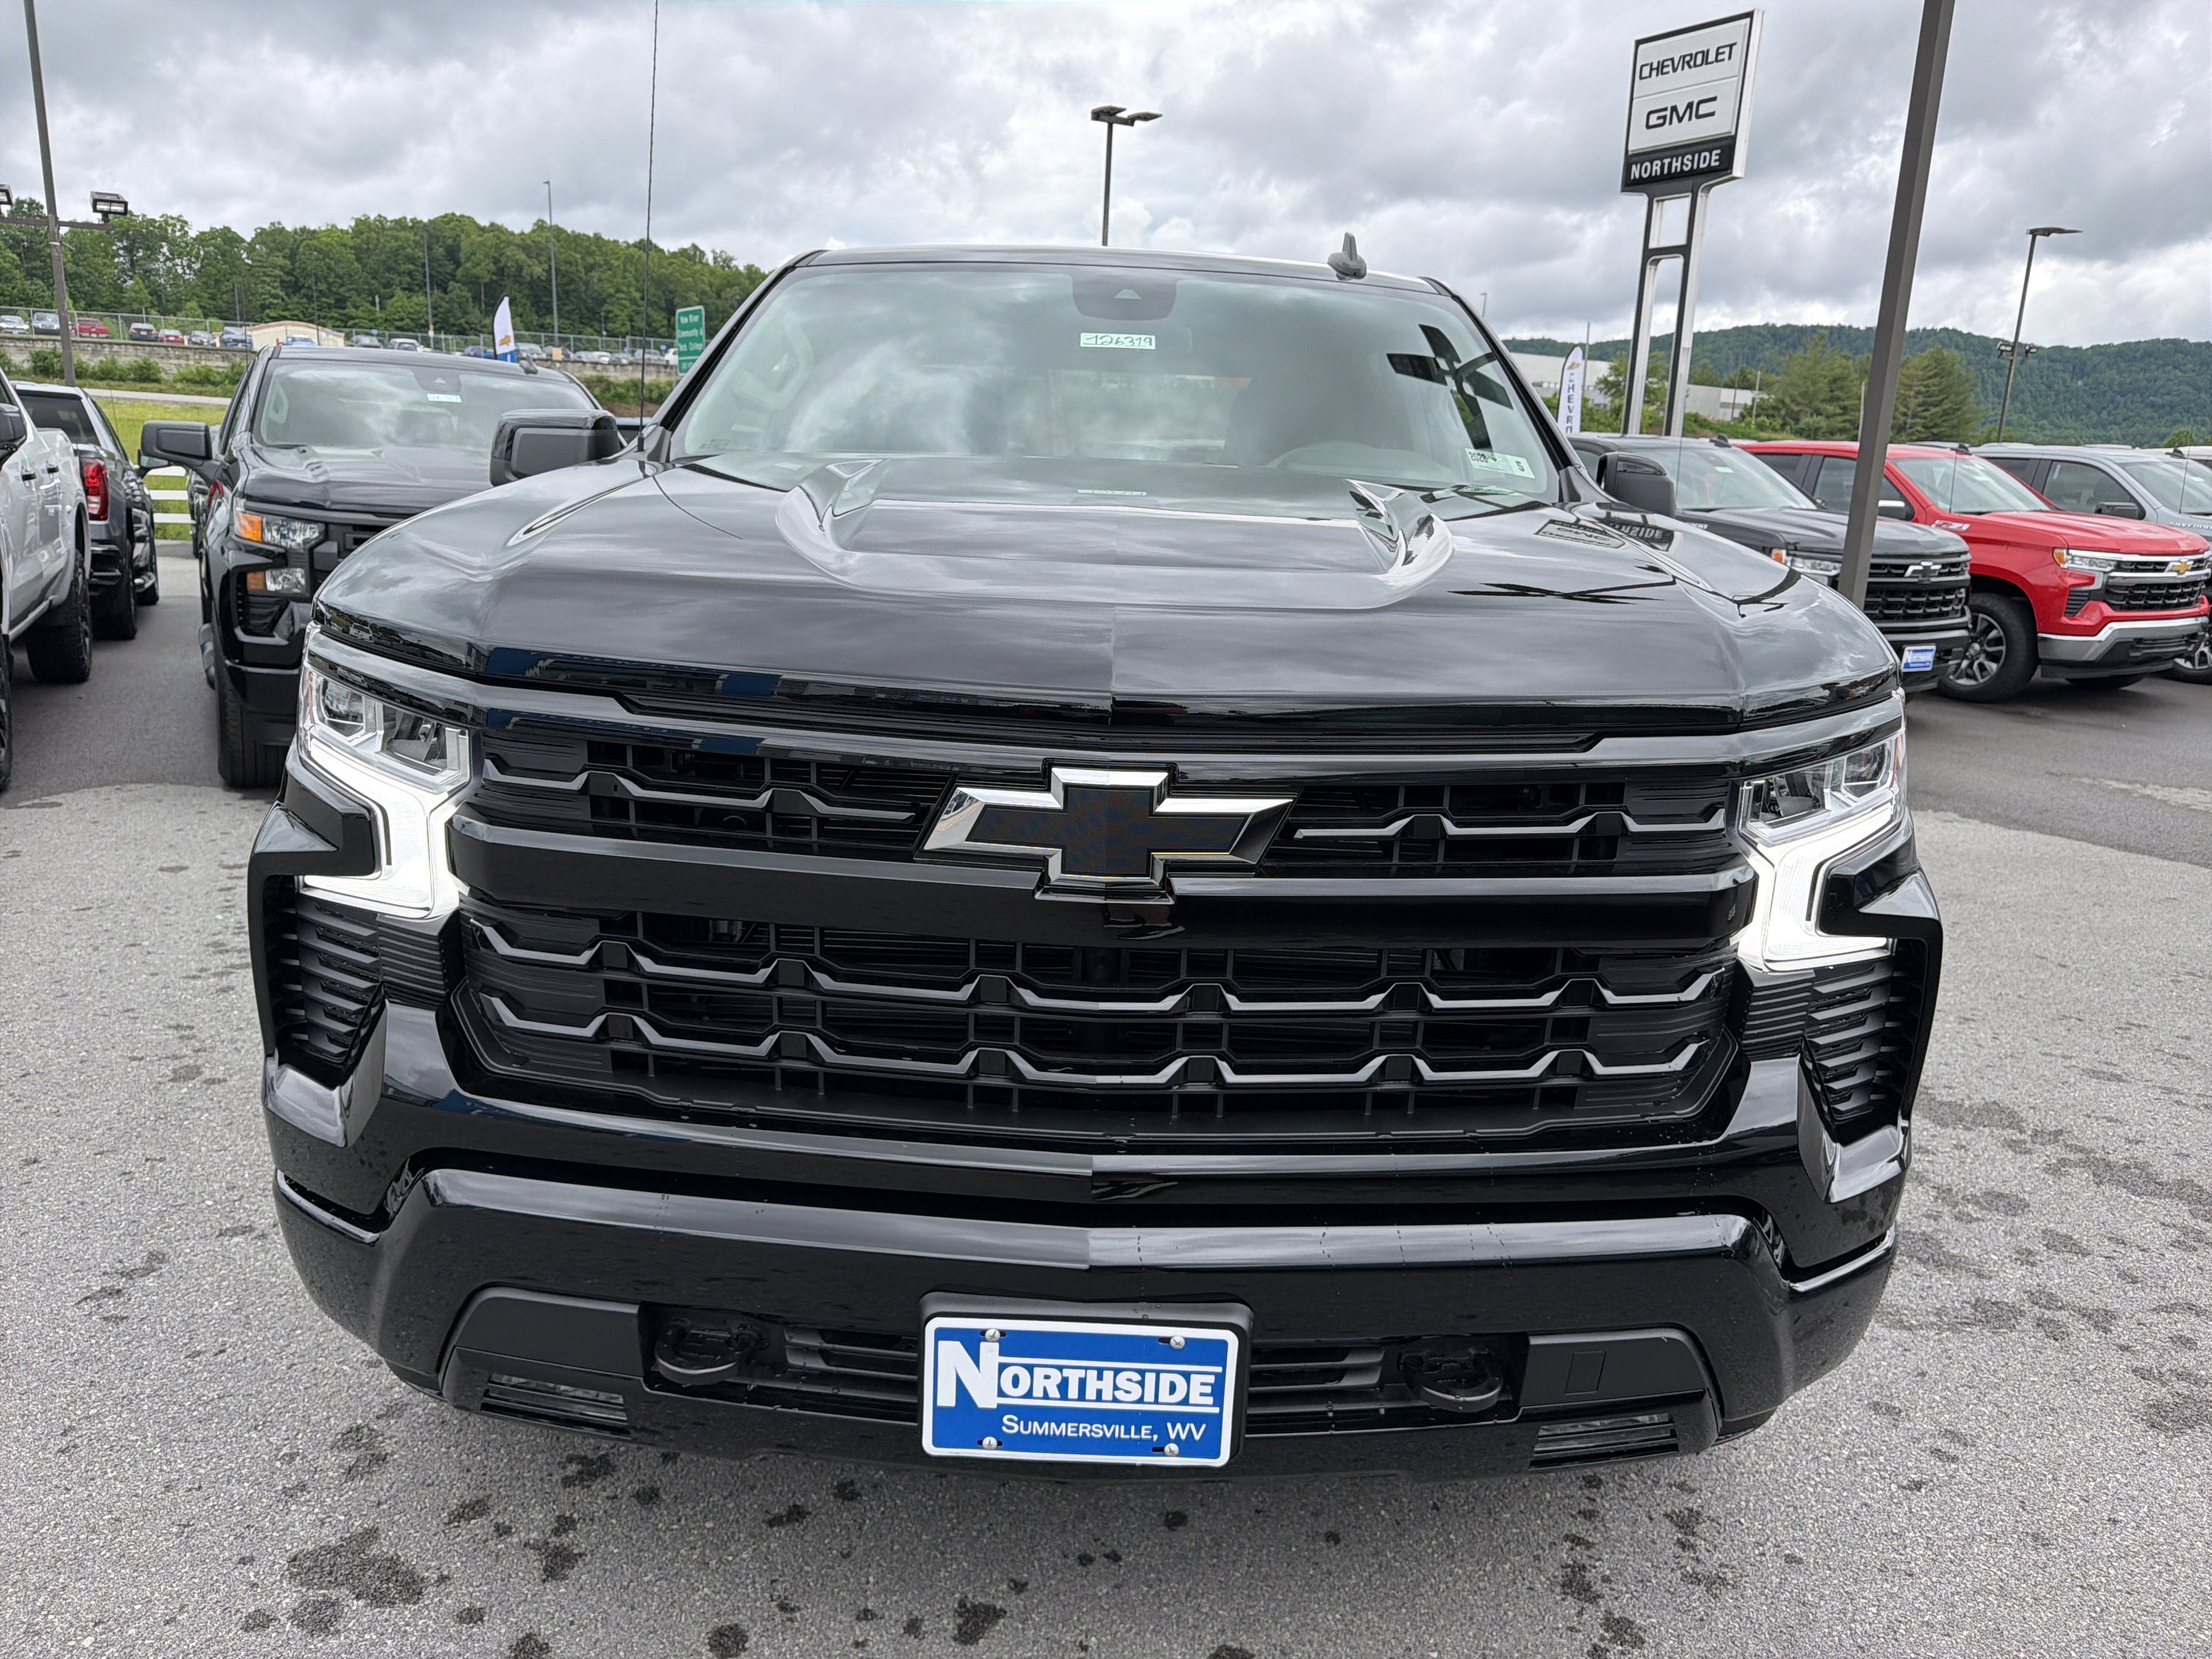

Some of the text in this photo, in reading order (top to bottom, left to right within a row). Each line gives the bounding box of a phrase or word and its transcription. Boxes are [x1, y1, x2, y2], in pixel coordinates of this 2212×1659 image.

[1639, 41, 1737, 81] CHEVROLET
[1645, 95, 1718, 130] GMC
[1630, 149, 1722, 180] NORTHSIDE
[1515, 460, 1525, 472] 5
[936, 1340, 1216, 1409] NORTHSIDE
[1001, 1414, 1207, 1442] SUMMERSVILLE, WV
